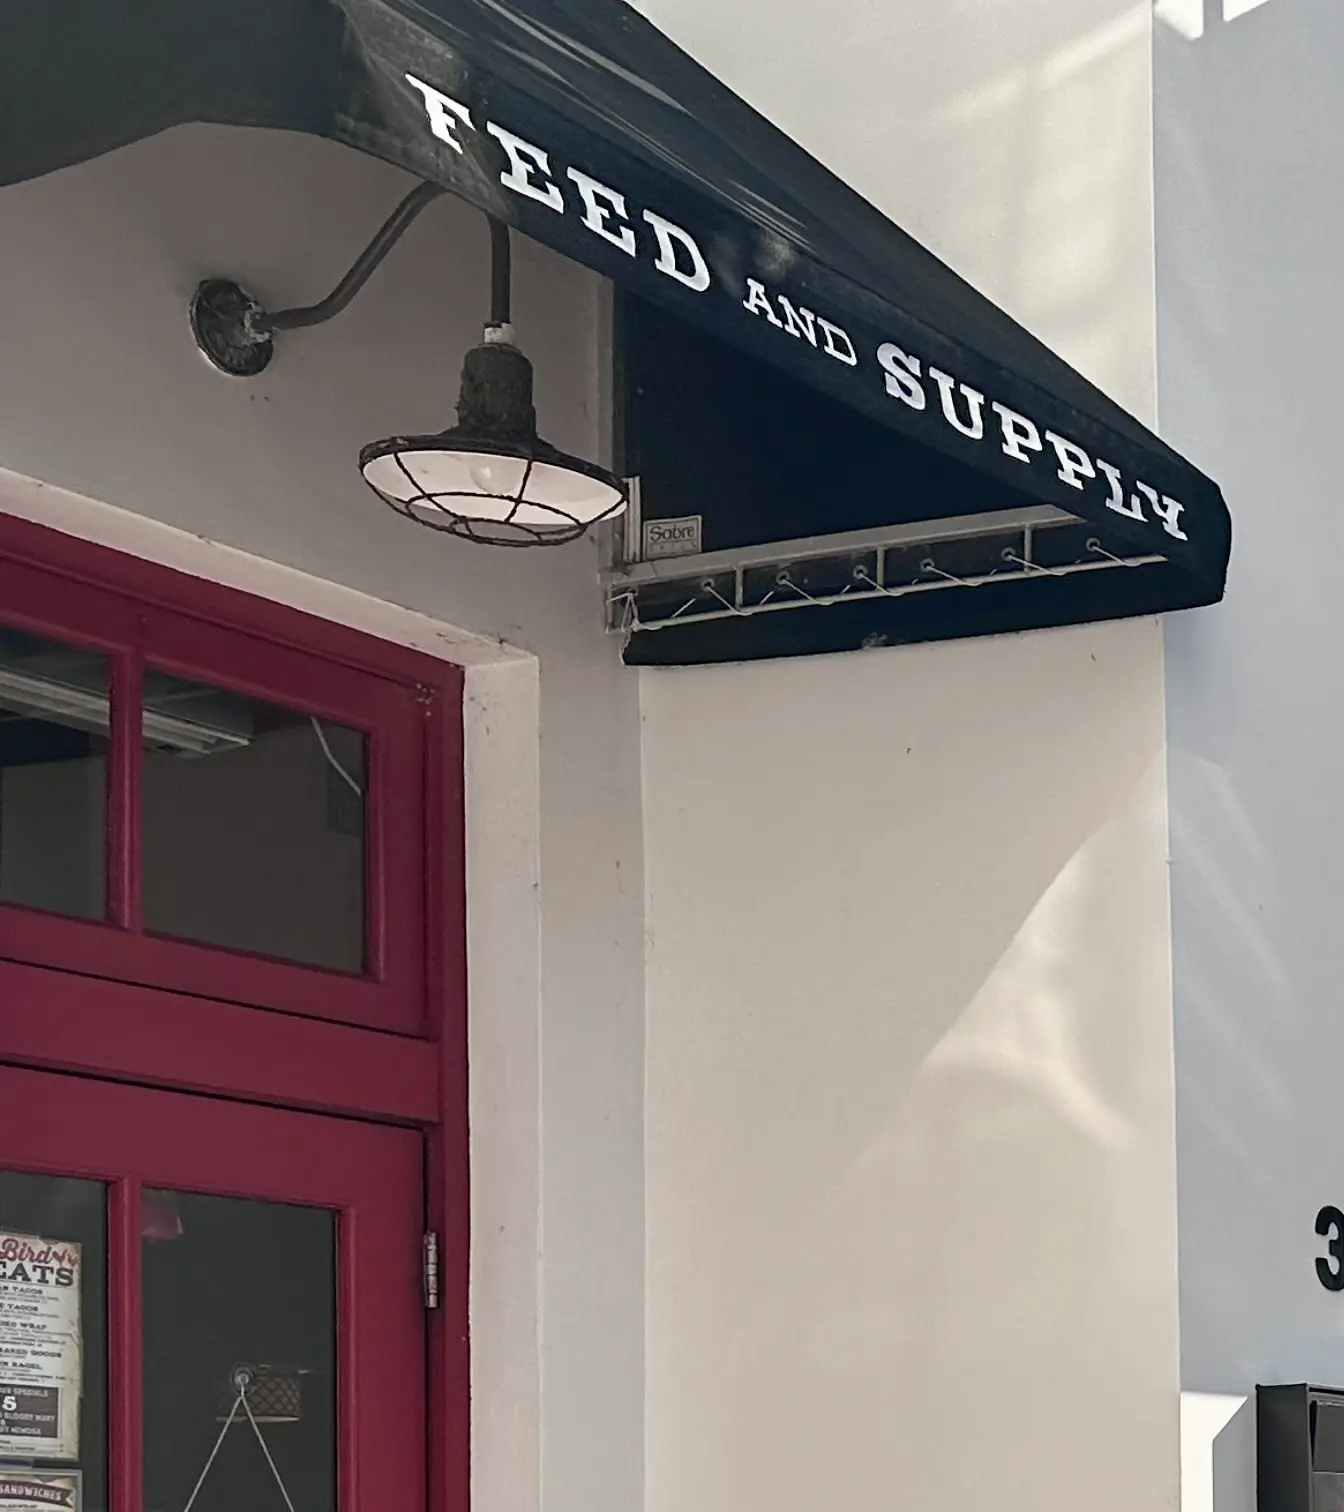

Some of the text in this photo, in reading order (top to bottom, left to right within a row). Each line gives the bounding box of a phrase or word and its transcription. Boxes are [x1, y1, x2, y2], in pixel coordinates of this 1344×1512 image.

[406, 74, 1189, 541] FEED AND SUPPLY
